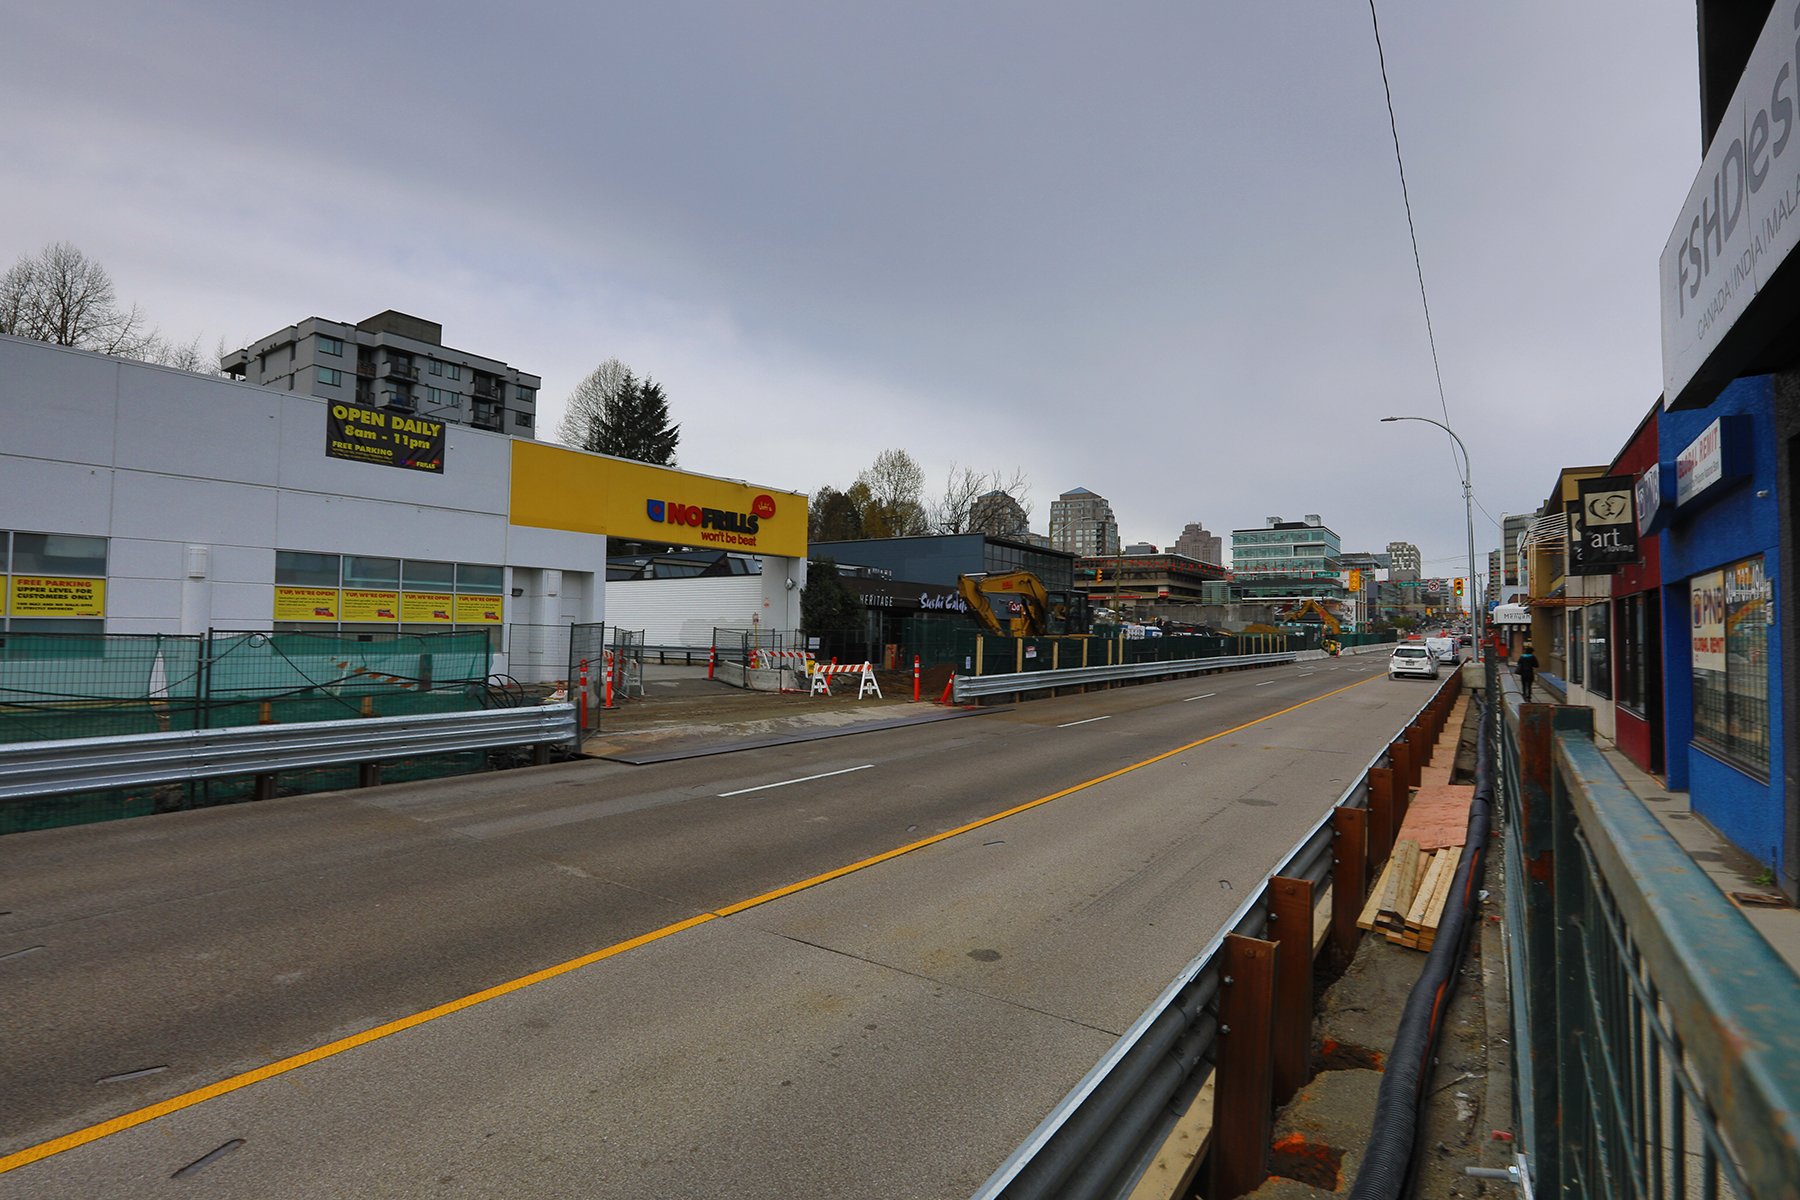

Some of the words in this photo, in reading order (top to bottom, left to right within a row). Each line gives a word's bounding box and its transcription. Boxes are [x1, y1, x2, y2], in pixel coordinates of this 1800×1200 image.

[332, 405, 385, 427] OPEN
[391, 416, 442, 437] DAILY
[344, 424, 377, 440] 8am
[393, 433, 431, 449] 11pm
[332, 441, 353, 450] FREE
[355, 445, 393, 457] PARKING
[701, 531, 724, 542] won't
[726, 533, 736, 544] be
[738, 535, 757, 546] beat
[1591, 528, 1621, 548] art
[919, 592, 944, 609] Sushi
[1702, 587, 1724, 625] PNB
